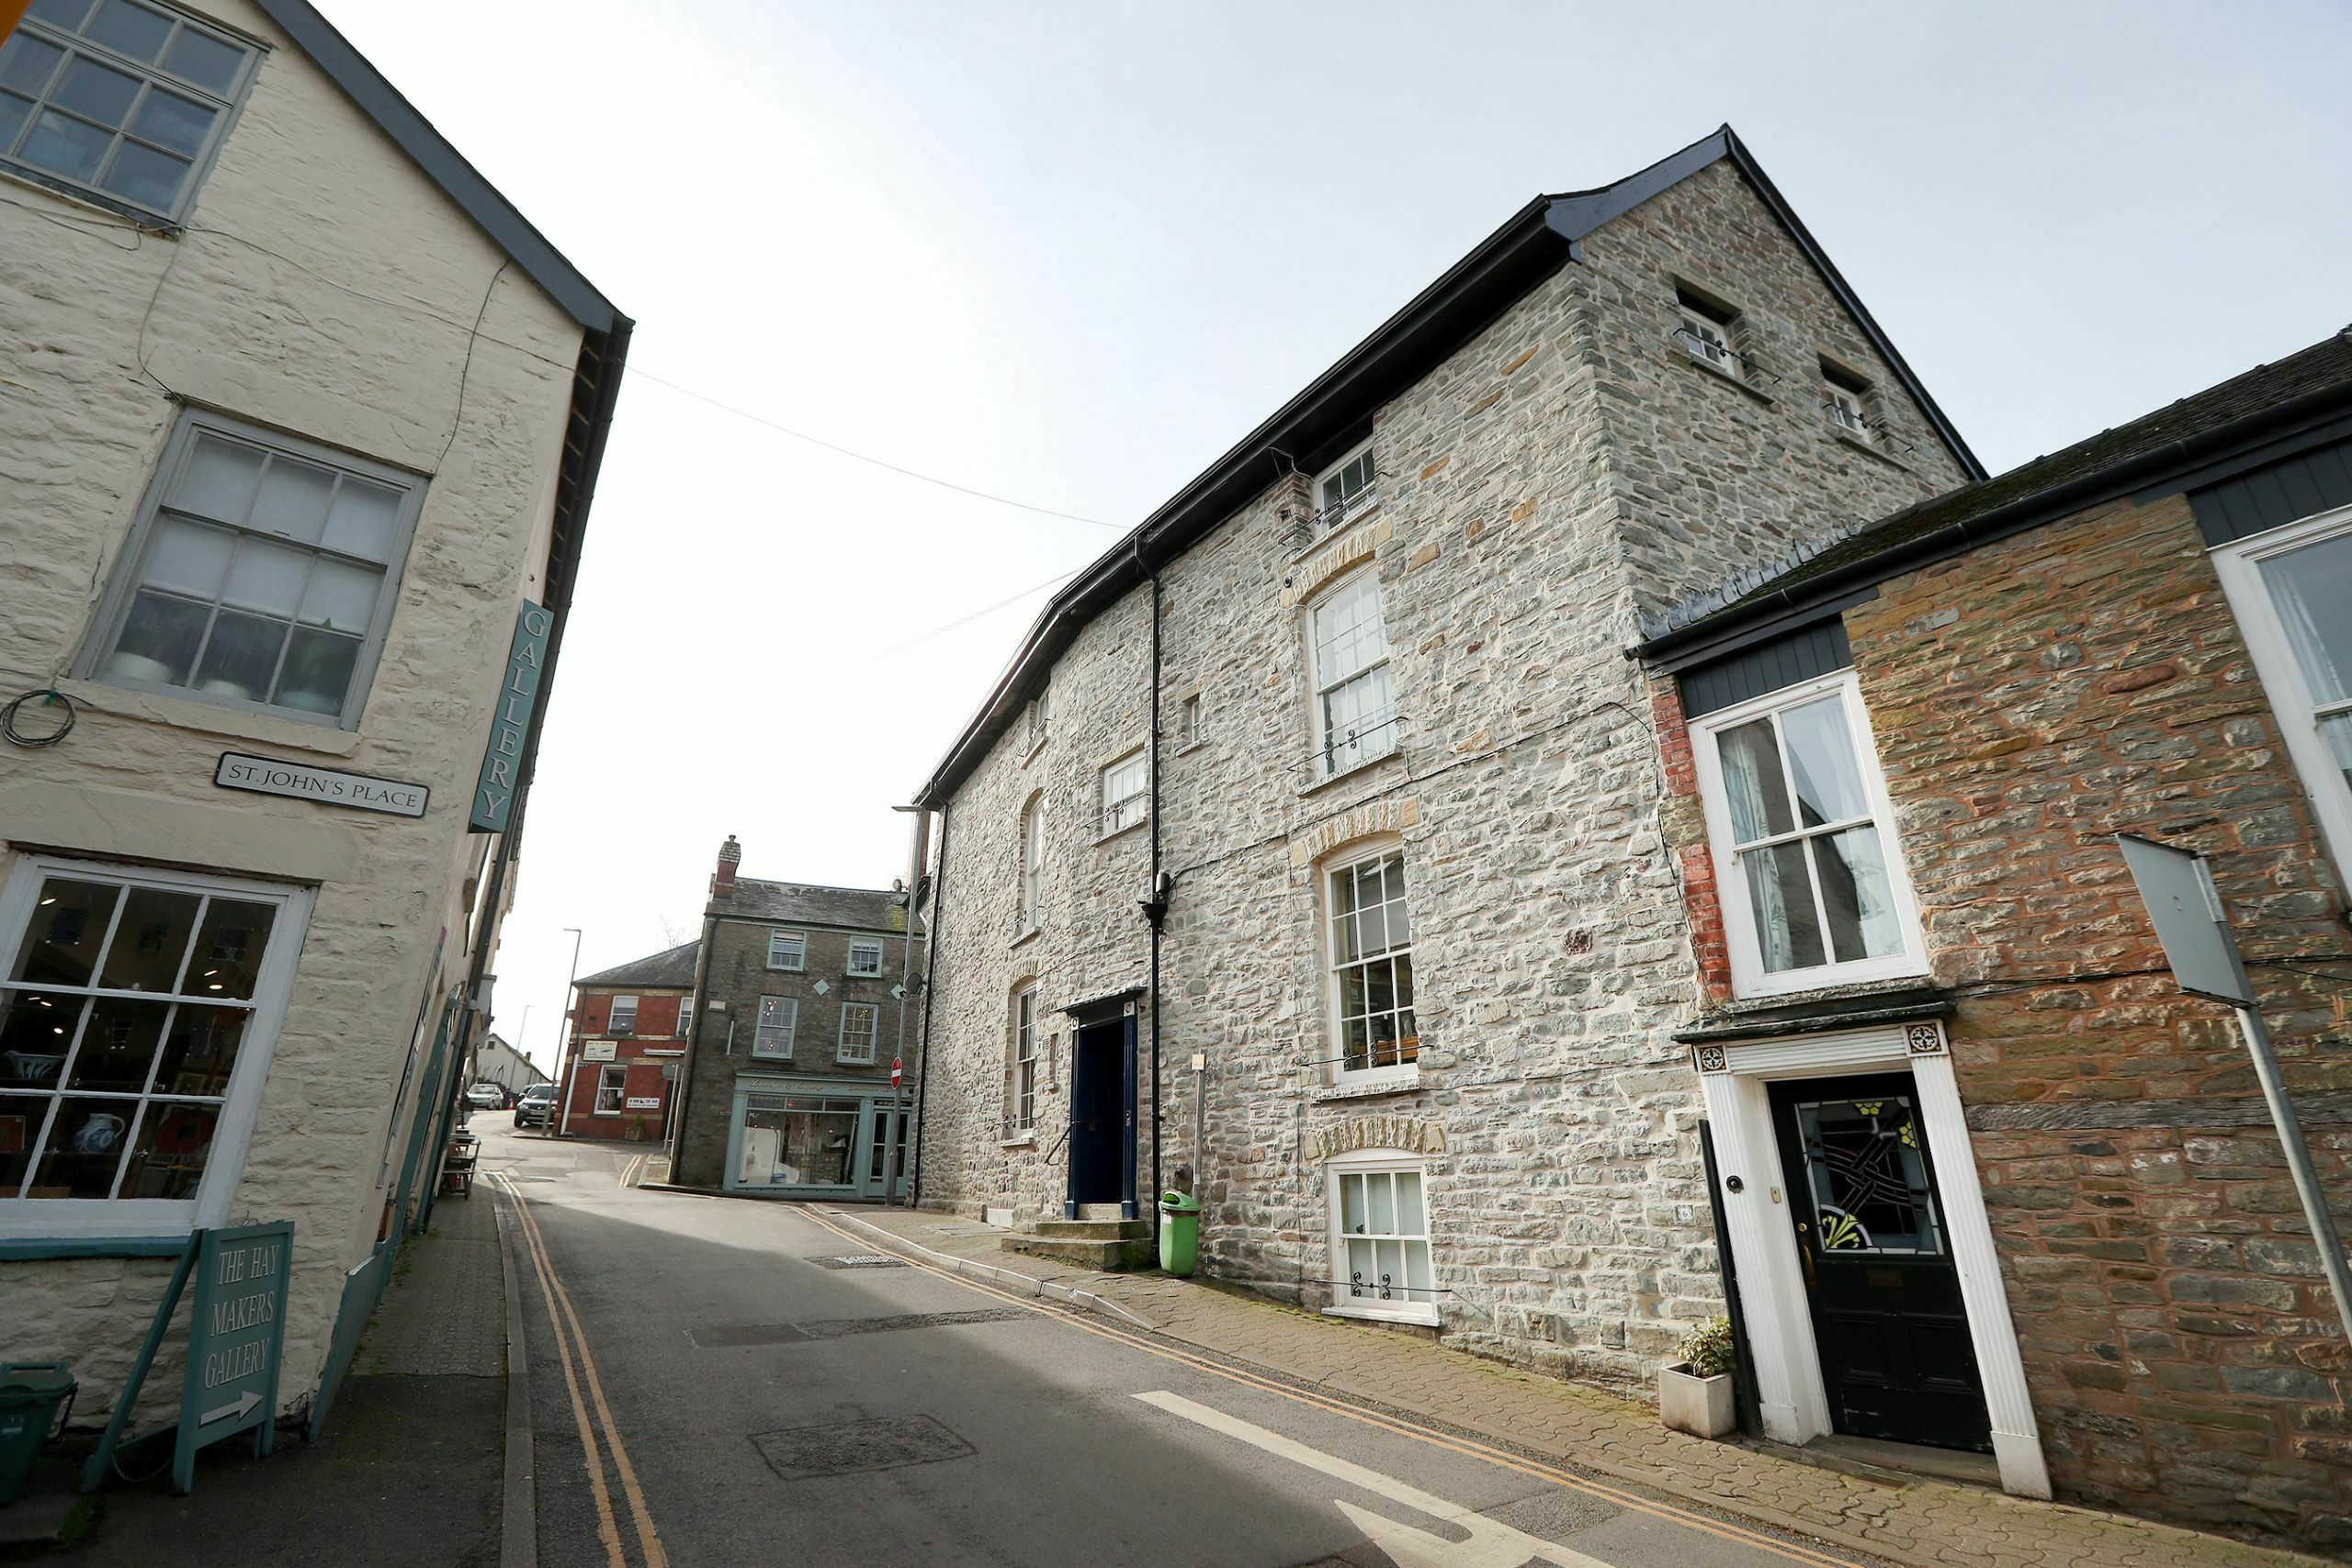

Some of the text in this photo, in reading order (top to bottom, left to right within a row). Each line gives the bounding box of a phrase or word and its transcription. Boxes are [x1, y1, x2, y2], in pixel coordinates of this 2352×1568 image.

[481, 610, 546, 820] GALLERY
[352, 784, 417, 807] PLACE
[217, 1245, 280, 1285] THE HAY
[209, 1291, 275, 1337] MAKERS
[205, 1337, 271, 1389] GALLERY
